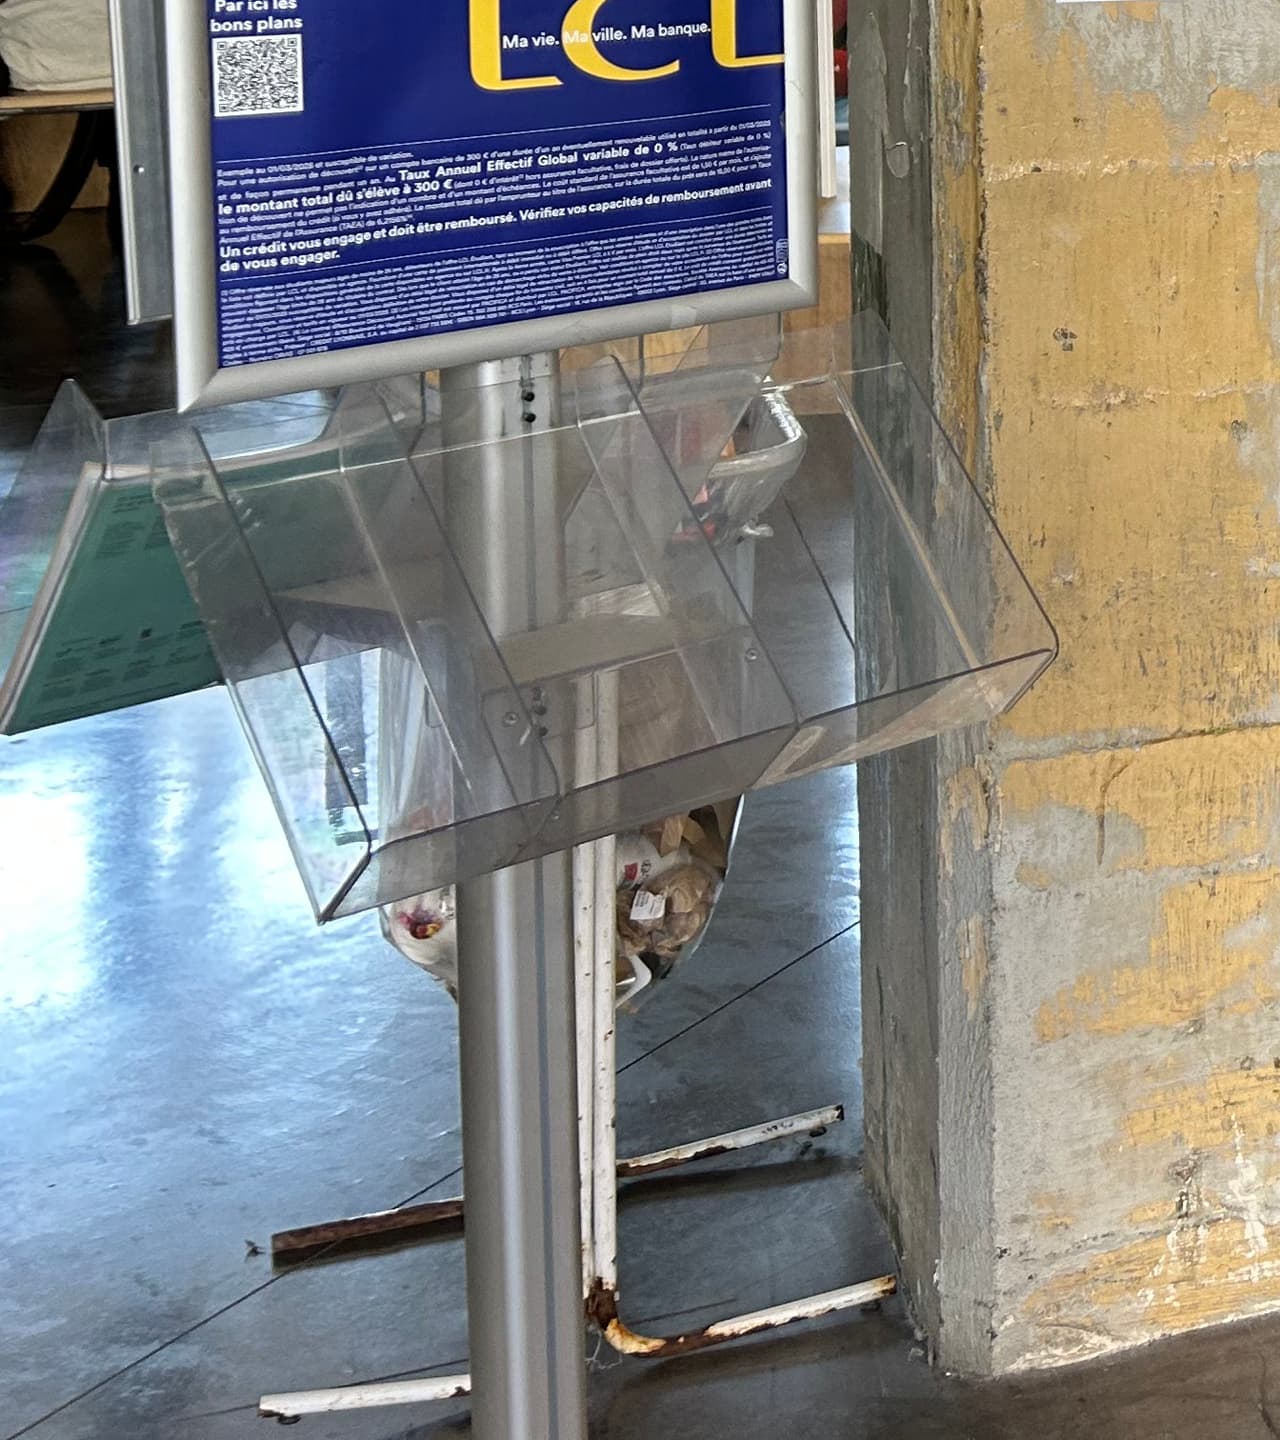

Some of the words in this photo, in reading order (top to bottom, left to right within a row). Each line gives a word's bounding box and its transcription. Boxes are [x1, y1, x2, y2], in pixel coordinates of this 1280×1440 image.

[210, 18, 253, 33] bons
[256, 15, 304, 33] plans
[502, 34, 529, 49] Ma
[532, 32, 560, 47] vie.
[562, 30, 590, 45] Ma
[592, 27, 628, 42] ville.
[631, 24, 656, 39] Ma
[658, 21, 712, 39] banque.
[398, 169, 432, 182] Taux
[435, 161, 482, 178] Annuel
[487, 155, 534, 172] Effectif
[537, 151, 578, 167] Global
[582, 146, 630, 162] variable
[634, 144, 650, 156] de
[653, 143, 663, 154] 0
[218, 203, 233, 216] le
[235, 197, 300, 214] montant
[300, 192, 334, 207] total
[336, 190, 355, 203] dû
[356, 186, 401, 201] s'élève
[402, 183, 412, 195] à
[413, 180, 441, 194] 300
[443, 178, 453, 190] €
[220, 246, 242, 259] Un
[242, 240, 288, 256] crédit
[288, 238, 322, 252] vous
[323, 231, 372, 247] engage
[373, 227, 388, 239] et
[388, 224, 415, 237] doit
[416, 221, 443, 233] être
[444, 211, 519, 231] remboursé.
[518, 206, 566, 221] Vérifiez
[567, 205, 588, 216] vos
[588, 196, 644, 213] capacités
[645, 193, 660, 205] de
[661, 182, 744, 203] remboursement
[745, 177, 773, 191] avant
[220, 259, 241, 273] de
[242, 258, 279, 270] vous
[280, 250, 341, 266] engager.
